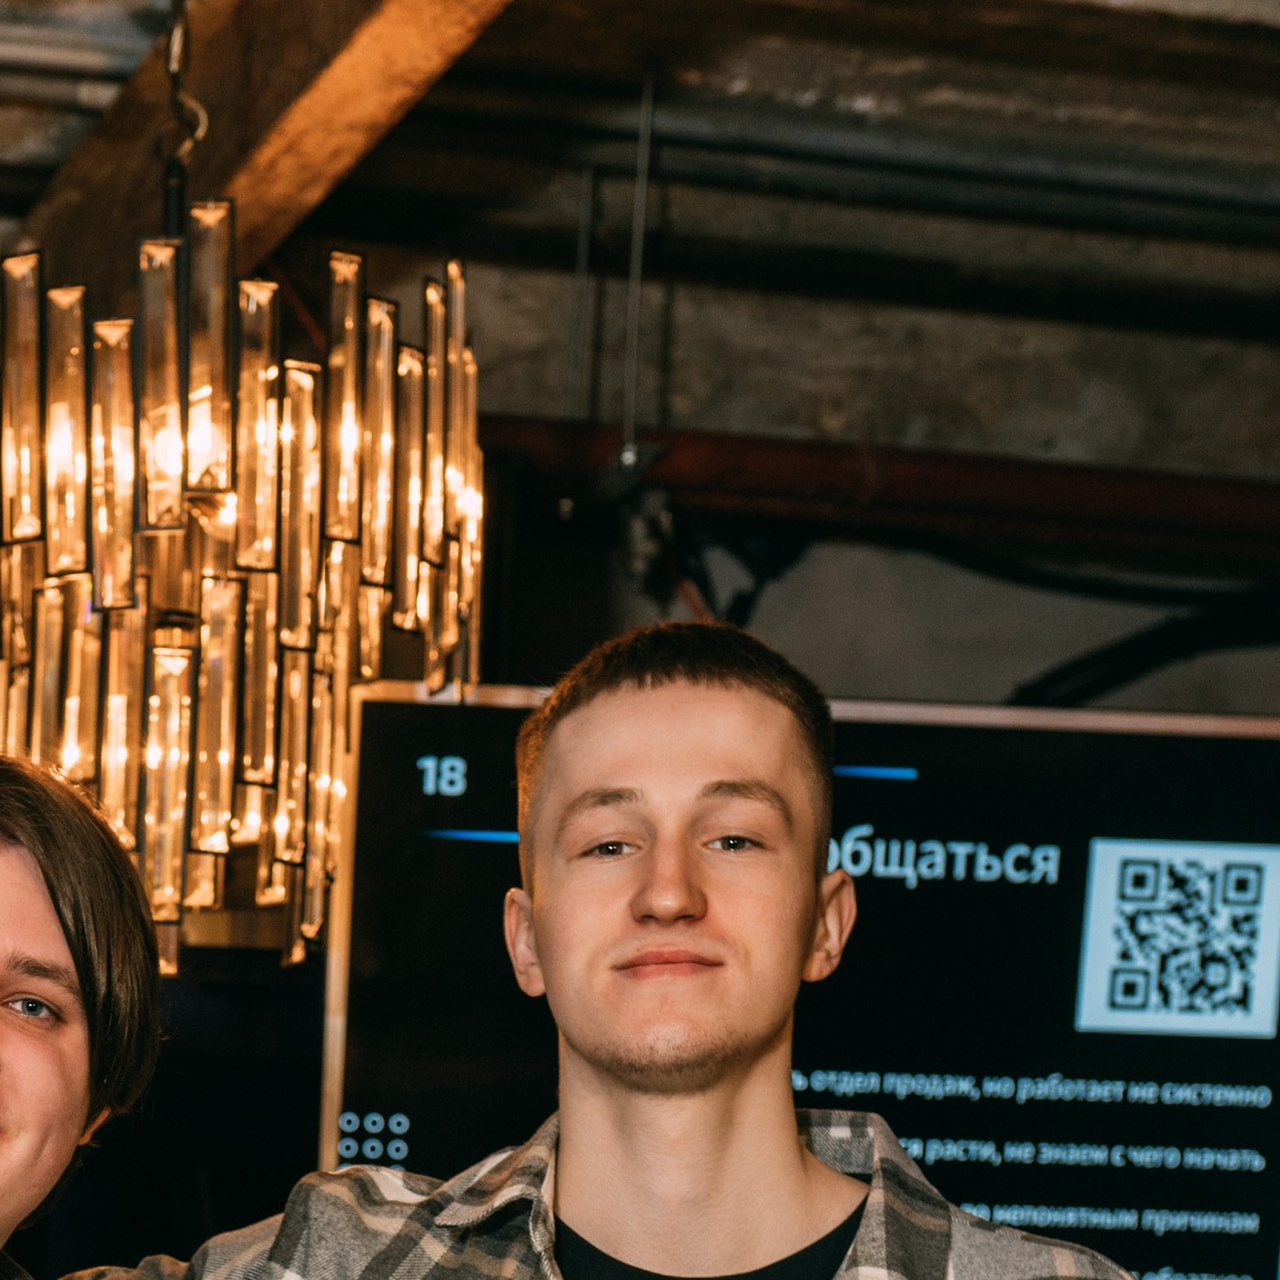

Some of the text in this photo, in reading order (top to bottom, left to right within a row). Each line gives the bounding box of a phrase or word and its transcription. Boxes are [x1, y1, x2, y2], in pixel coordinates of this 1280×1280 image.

[416, 754, 468, 796] 18
[810, 1070, 881, 1097] отдел
[883, 1072, 980, 1100] продаж,
[982, 1076, 1015, 1099] но
[1016, 1073, 1126, 1105] работает
[1128, 1081, 1159, 1104] не
[1161, 1082, 1272, 1108] системно
[925, 1138, 1002, 1166] расти,
[1004, 1141, 1036, 1164] не
[1037, 1142, 1108, 1166] знаем
[1110, 1145, 1126, 1167] с
[1127, 1145, 1181, 1169] чего
[1183, 1148, 1266, 1172] начать
[992, 1204, 1138, 1230] непонятным
[1141, 1209, 1260, 1236] причинам
